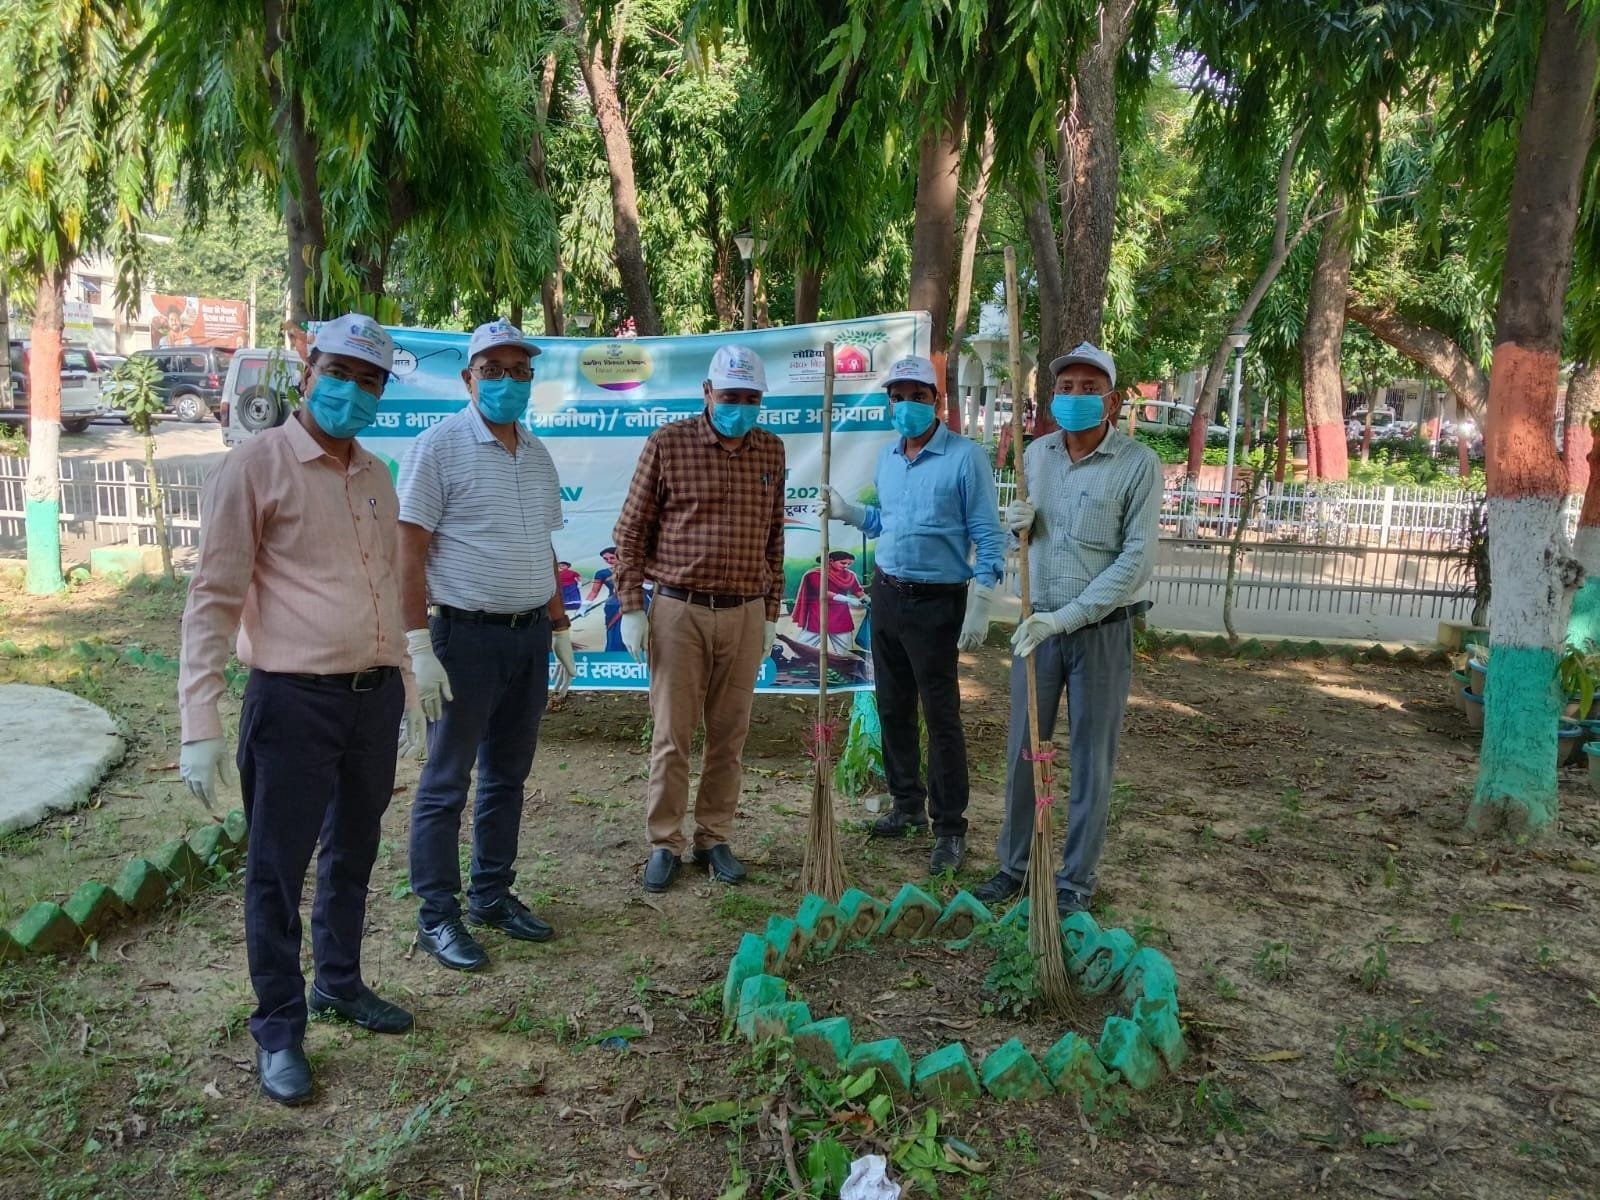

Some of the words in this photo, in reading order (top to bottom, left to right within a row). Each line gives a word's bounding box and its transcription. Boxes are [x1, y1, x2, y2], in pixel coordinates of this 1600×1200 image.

[406, 412, 455, 428] भार
[805, 402, 886, 424] अभियान
[786, 487, 819, 499] 202
